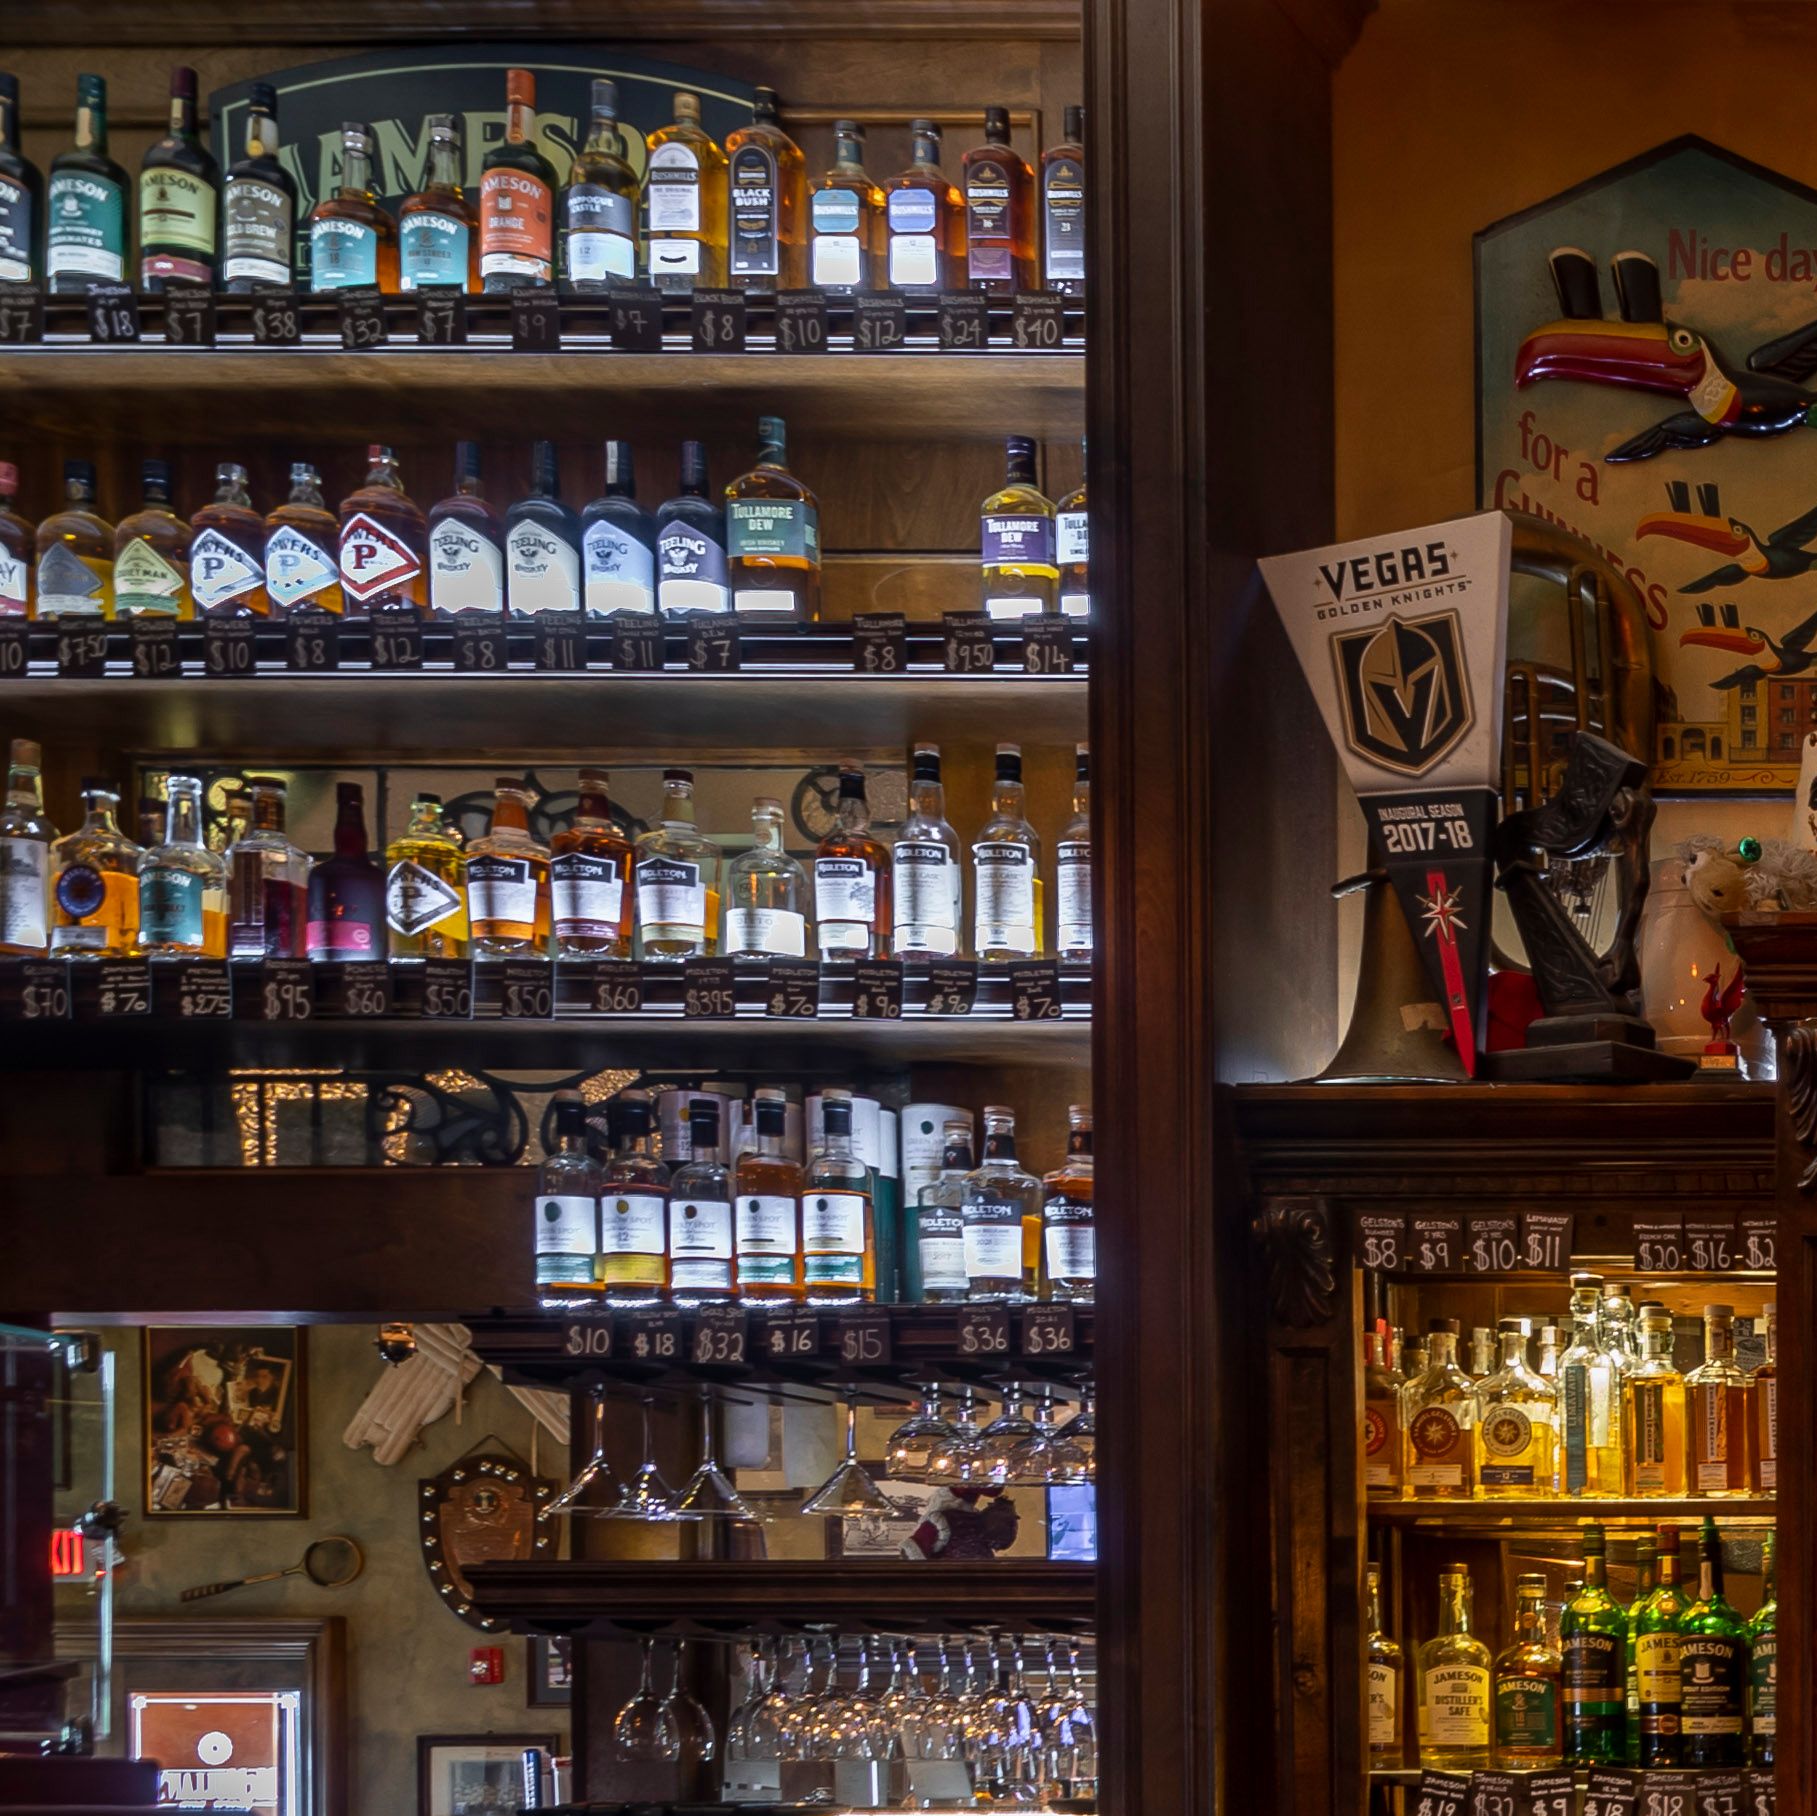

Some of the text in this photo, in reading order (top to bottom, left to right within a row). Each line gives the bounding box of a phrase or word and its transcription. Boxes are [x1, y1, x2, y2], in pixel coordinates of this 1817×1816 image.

[732, 188, 772, 200] BLACK
[734, 196, 770, 207] BUSH
[1669, 228, 1752, 281] Nice
[253, 308, 297, 340] $38
[700, 316, 735, 347] $8
[778, 318, 822, 348] $10
[858, 322, 897, 348] $12
[941, 318, 984, 348] $24
[1014, 318, 1059, 348] $40
[1519, 411, 1599, 505] for a
[729, 503, 795, 521] TULLAMORE
[747, 518, 775, 532] DEW
[986, 518, 1040, 533] TULLAMORE
[432, 536, 481, 556] TEELING
[510, 535, 557, 555] TEELING
[658, 535, 706, 556] TEELING
[1001, 531, 1023, 543] DEW
[351, 543, 377, 571] P
[1320, 541, 1448, 601] VEGAS
[1317, 596, 1384, 620] GOLDEN
[207, 643, 249, 674] $10
[373, 633, 421, 665] $12
[462, 640, 495, 671] $8
[690, 639, 730, 667] $7
[863, 644, 895, 670] $8
[1025, 642, 1069, 672] $14
[1378, 804, 1465, 823] INAUGURAL SEASON
[1383, 821, 1473, 853] 2017-18
[264, 985, 311, 1020] $95
[506, 985, 552, 1016] $50
[596, 985, 640, 1012] $60
[685, 989, 734, 1016] $395
[1363, 1237, 1398, 1269] $8
[1420, 1242, 1449, 1270] $9
[1473, 1239, 1515, 1271] $10
[1525, 1233, 1560, 1267] $11
[1638, 1242, 1680, 1271] $20
[1691, 1242, 1731, 1271] $16
[566, 1324, 610, 1356] $10
[634, 1334, 676, 1357] $18
[696, 1328, 745, 1362] $32
[771, 1328, 813, 1353] $16
[842, 1328, 883, 1362] $15
[962, 1324, 1009, 1352] $36
[1028, 1324, 1072, 1353] $36
[1433, 1670, 1483, 1686] JAMESON
[1448, 1706, 1471, 1717] SAFE
